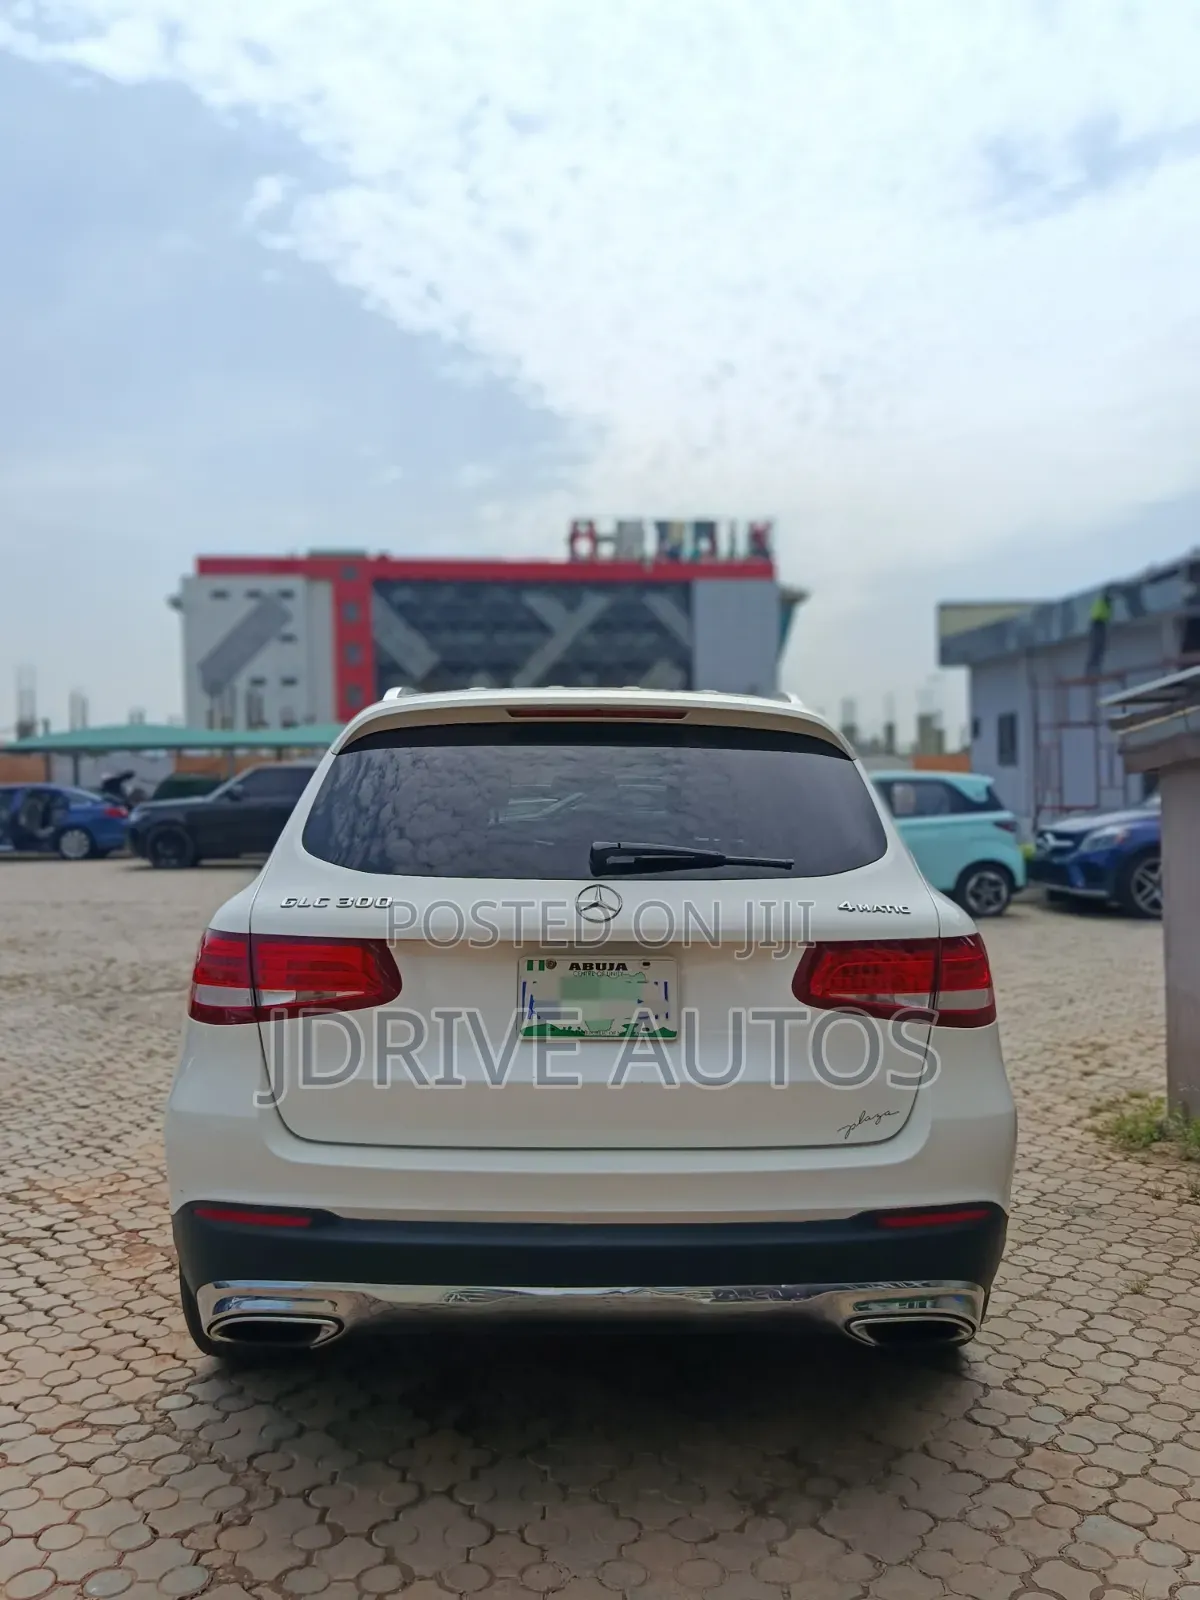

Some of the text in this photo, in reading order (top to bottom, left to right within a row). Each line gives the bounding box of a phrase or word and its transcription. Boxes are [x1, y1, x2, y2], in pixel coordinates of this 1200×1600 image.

[280, 897, 393, 908] GLC 300
[838, 901, 911, 914] 4MATIC
[569, 962, 628, 971] ABUJA
